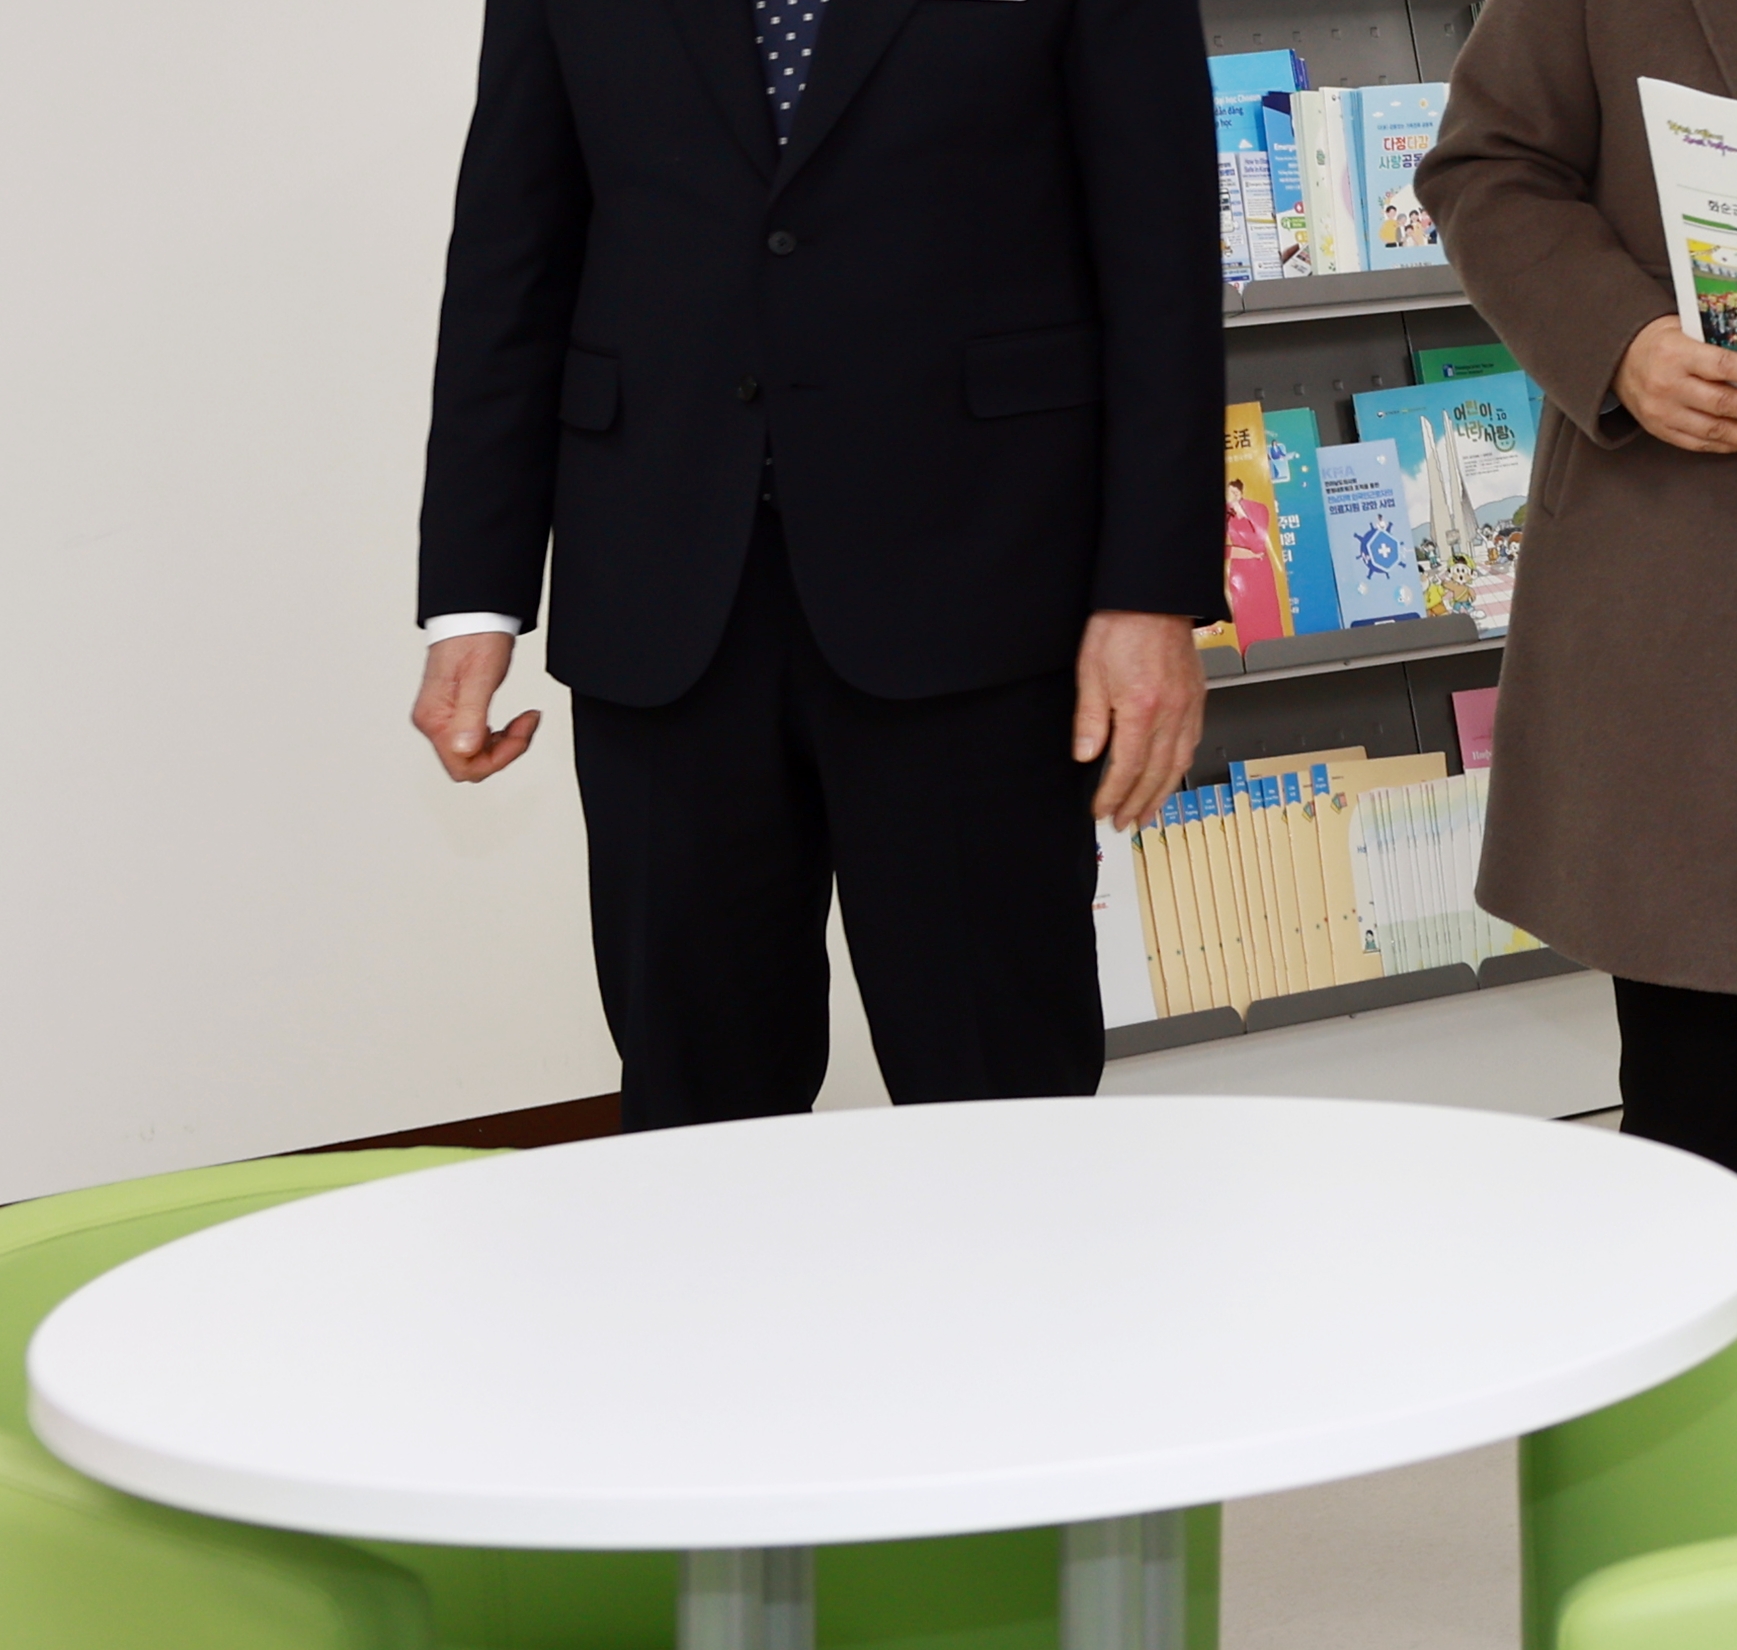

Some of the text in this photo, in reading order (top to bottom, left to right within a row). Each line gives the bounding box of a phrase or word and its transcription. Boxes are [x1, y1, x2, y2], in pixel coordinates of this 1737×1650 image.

[1383, 135, 1429, 151] 다정다감
[1378, 153, 1425, 170] 사랑공동
[1329, 498, 1396, 516] 의료지원 강화 사업
